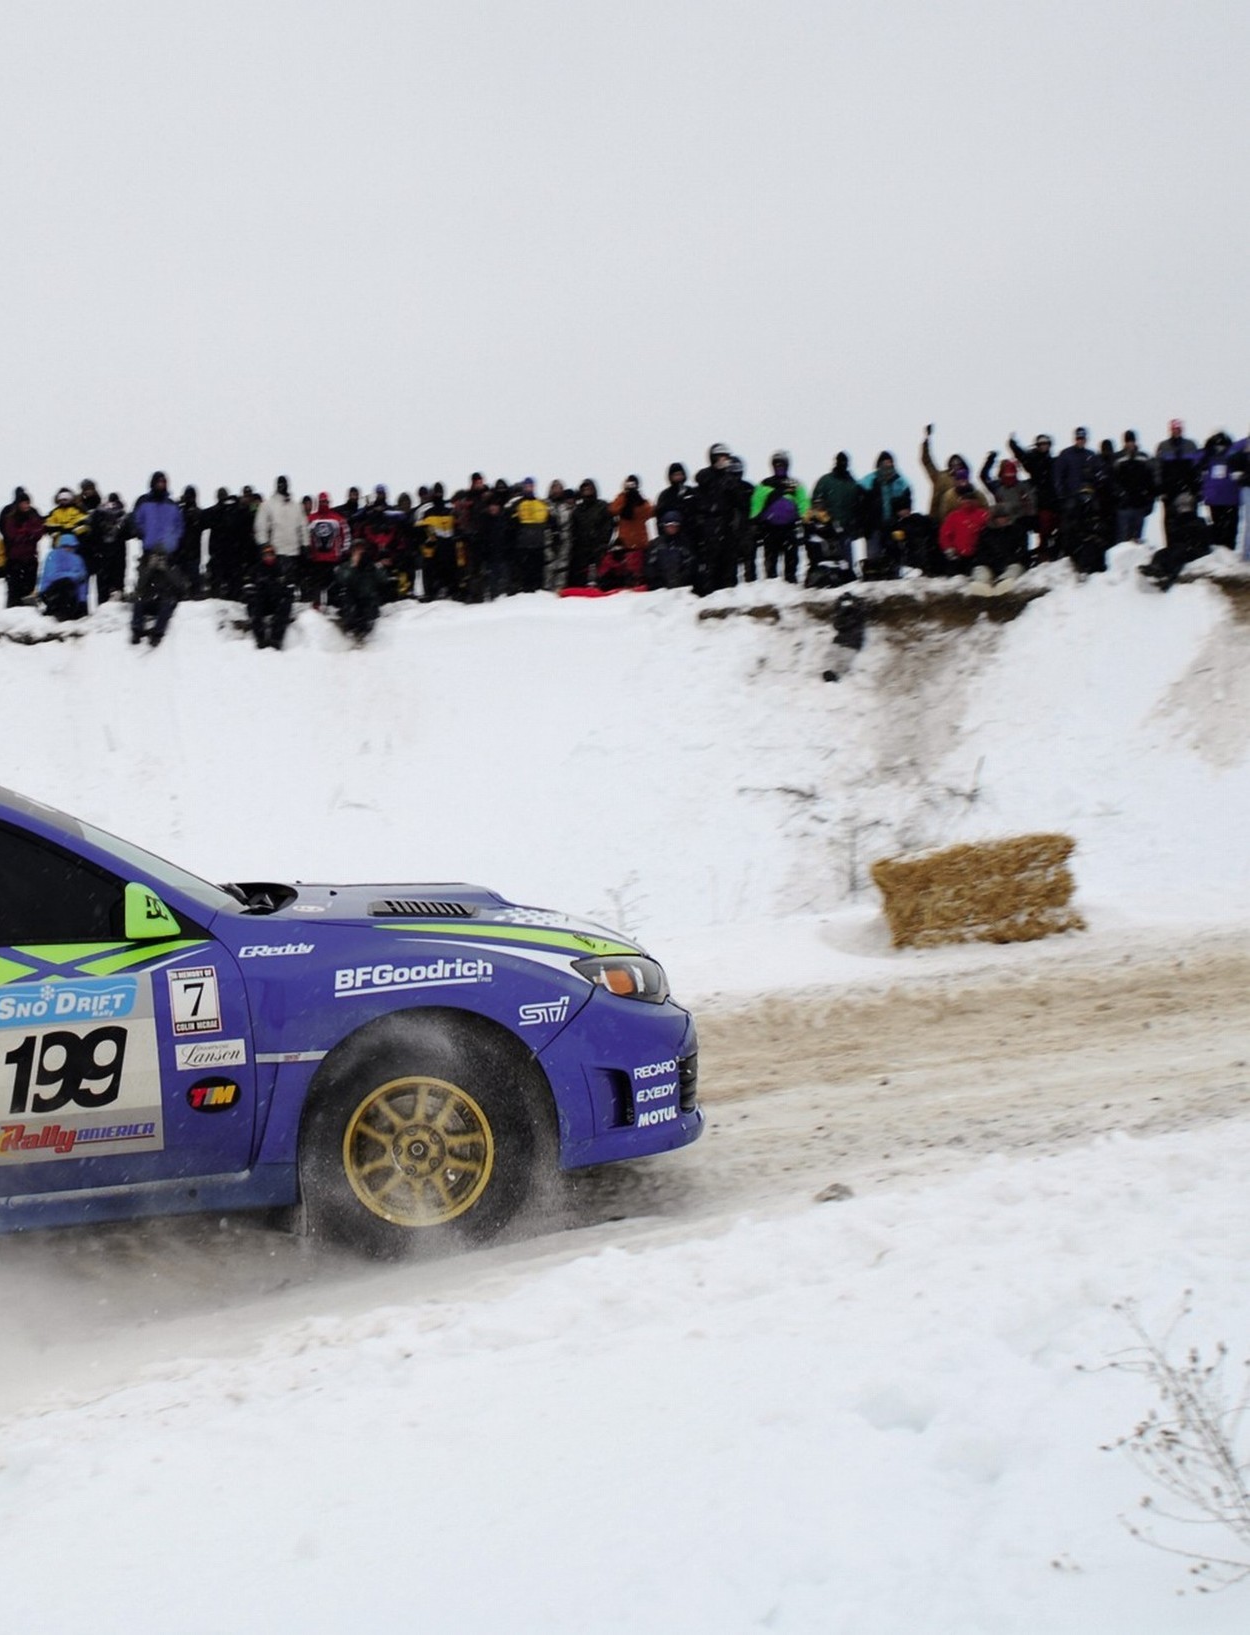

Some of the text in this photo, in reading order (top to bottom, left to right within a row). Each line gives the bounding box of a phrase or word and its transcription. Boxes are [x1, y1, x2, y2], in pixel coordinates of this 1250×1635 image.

[238, 943, 315, 958] GReddy
[334, 959, 493, 991] BFGoodrich
[54, 992, 126, 1016] DRIFT
[183, 982, 205, 1017] 7
[181, 1044, 241, 1068] Lanson
[4, 1025, 128, 1114] 199
[633, 1059, 676, 1080] RECARO
[636, 1082, 677, 1103] EXEDY
[637, 1105, 678, 1128] MOTUL
[0, 1122, 155, 1153] Rally AMERICA
